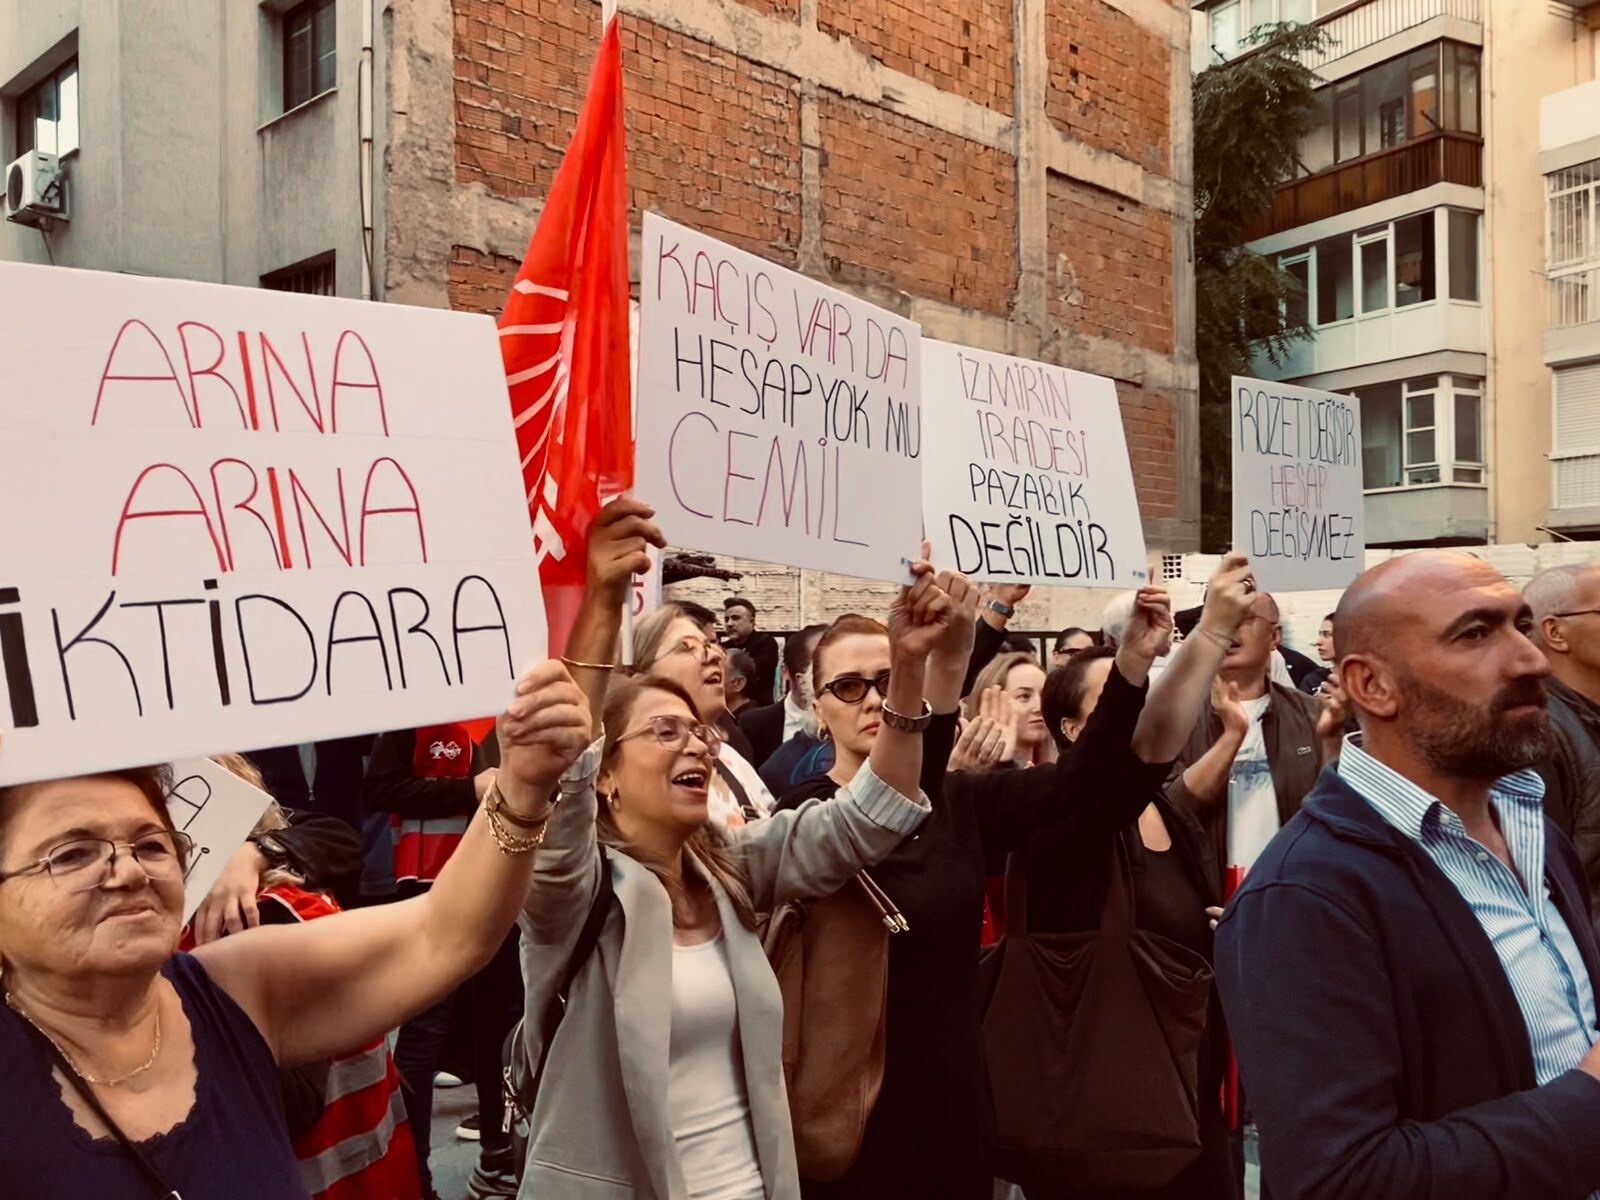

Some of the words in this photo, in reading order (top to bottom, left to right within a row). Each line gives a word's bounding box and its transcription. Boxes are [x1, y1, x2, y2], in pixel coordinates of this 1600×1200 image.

[658, 235, 777, 352] KAÇIŞ
[794, 289, 854, 372] VAR
[866, 318, 908, 389] DA
[92, 319, 389, 437] ARINA
[675, 327, 812, 427] HESAP
[817, 373, 870, 449] YOK
[886, 396, 920, 458] MU
[957, 352, 1072, 421] İZMİRİN
[1239, 387, 1303, 458] ROZET
[112, 457, 428, 576] ARINA
[669, 411, 869, 547] CEMİL
[1251, 507, 1355, 561] DEĞİŞMEZ
[1271, 463, 1328, 509] HESAP
[949, 513, 1115, 581] DEĞİLDİR
[0, 575, 515, 728] İKTİDARA
